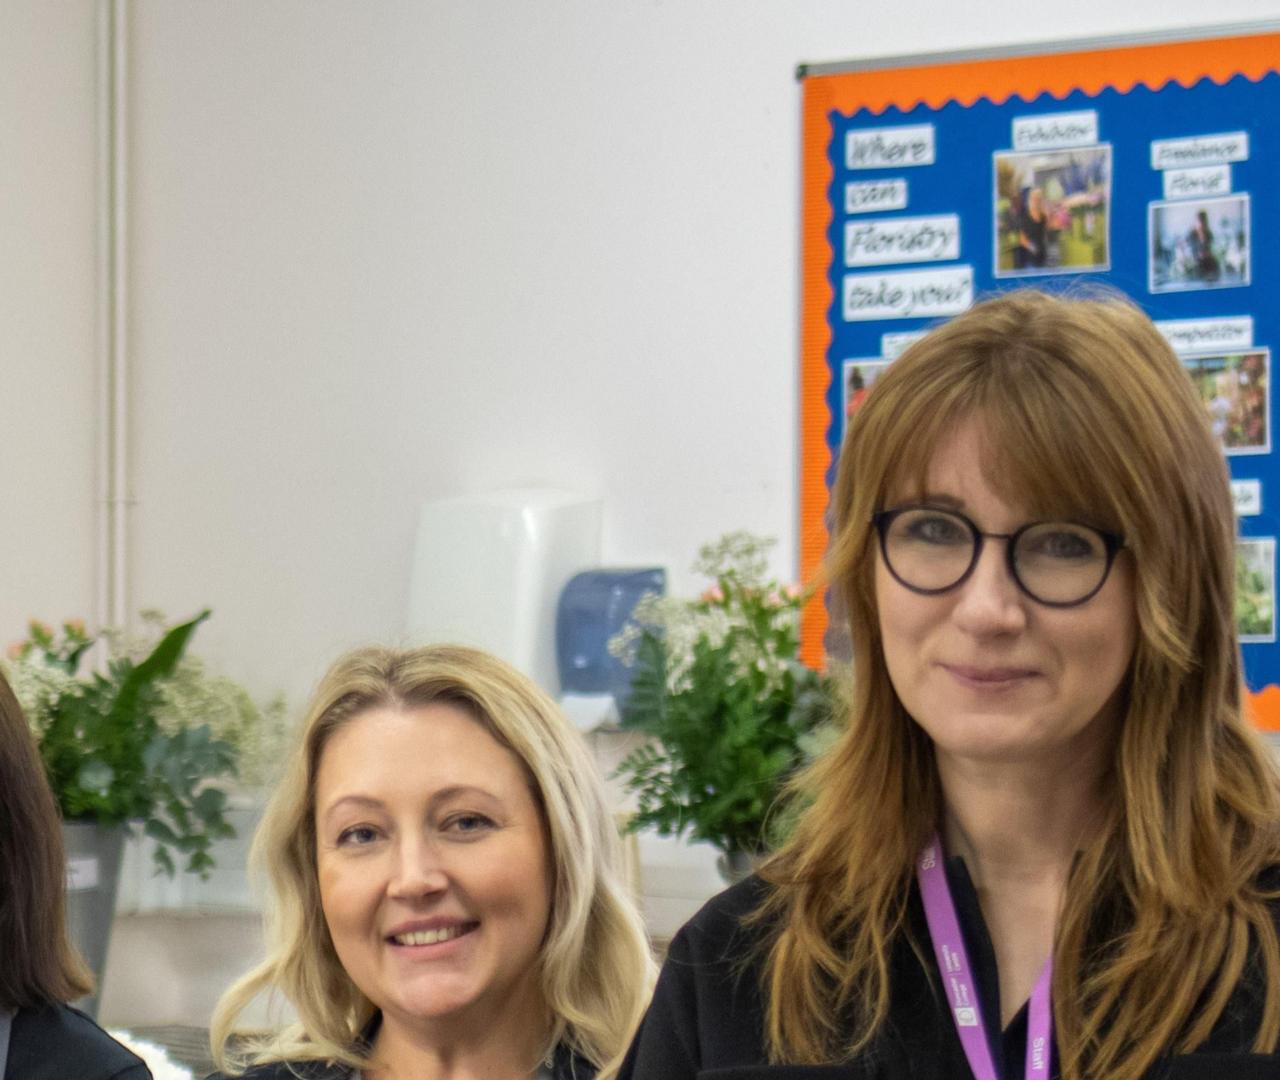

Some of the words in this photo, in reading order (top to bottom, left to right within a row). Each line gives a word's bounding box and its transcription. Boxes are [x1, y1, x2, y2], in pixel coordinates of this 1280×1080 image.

[852, 135, 926, 164] Where
[851, 225, 952, 256] Floristry
[851, 281, 902, 310] take
[1032, 1036, 1045, 1071] Staff
